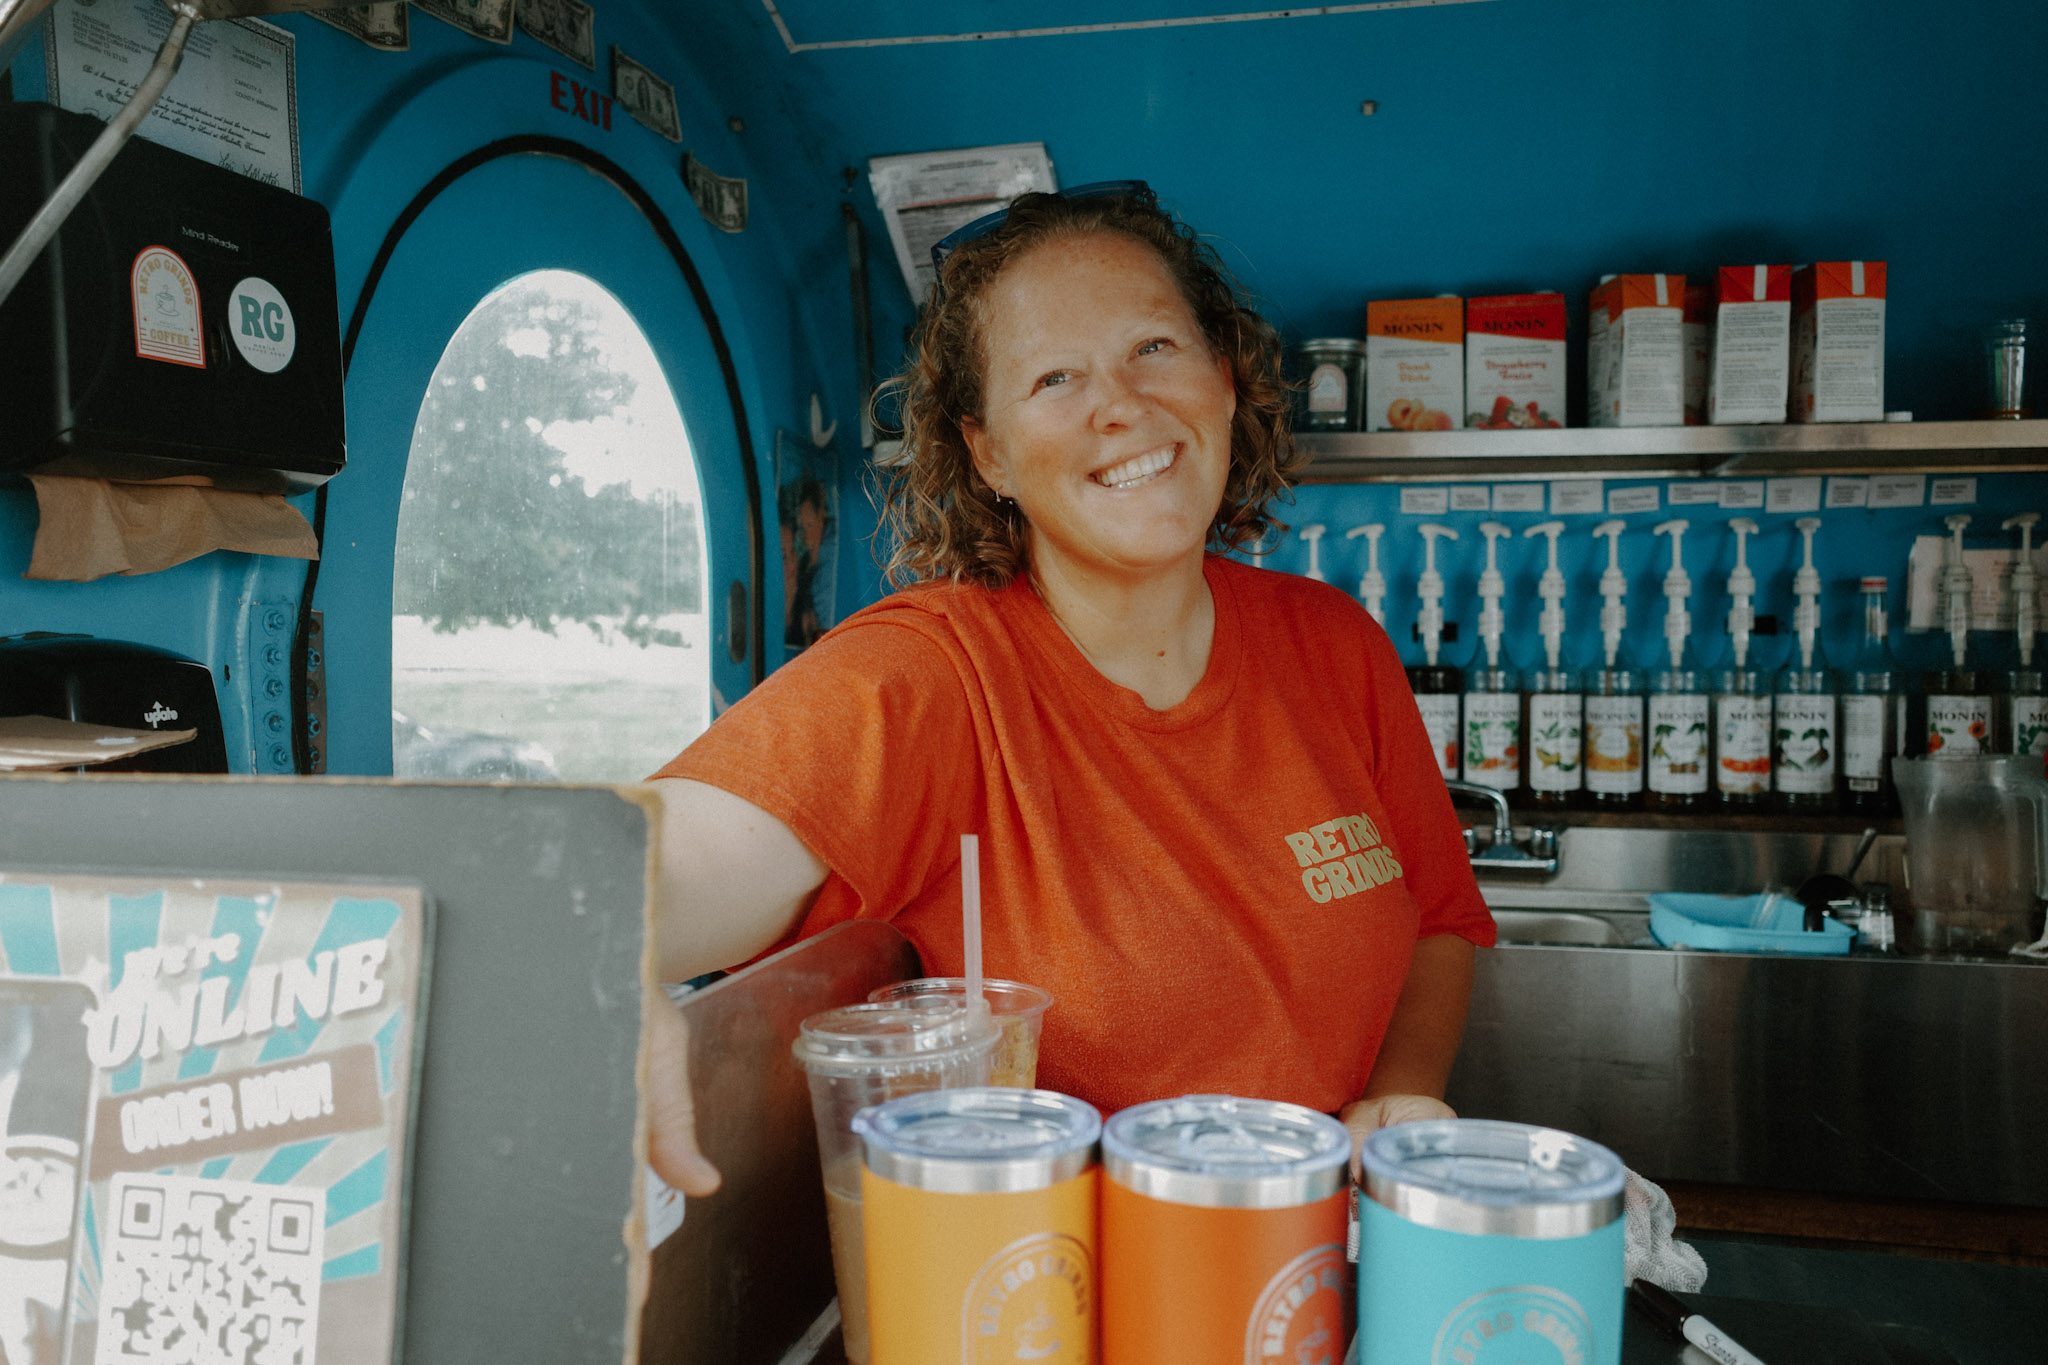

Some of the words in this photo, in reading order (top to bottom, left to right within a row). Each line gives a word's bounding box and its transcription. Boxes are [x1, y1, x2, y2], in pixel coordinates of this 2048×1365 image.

[550, 70, 611, 131] EXIT
[182, 226, 205, 240] Mind
[206, 233, 240, 252] Reader
[139, 258, 162, 294] RETRO
[163, 259, 193, 305] GRINDS
[150, 328, 190, 346] COFFEE
[239, 294, 285, 342] RG
[1383, 321, 1443, 335] MONIN
[1483, 318, 1545, 331] MONIN
[1931, 711, 1987, 721] MONIN
[1284, 812, 1382, 868] RETRO
[1302, 845, 1403, 904] GRINDS
[82, 938, 389, 1069] ONLINE
[120, 1082, 237, 1154] ORDER
[239, 1061, 334, 1131] NOW!
[979, 1259, 1036, 1336] RETRO
[1262, 1273, 1317, 1357] RETRO
[1453, 1311, 1515, 1365] ETRO
